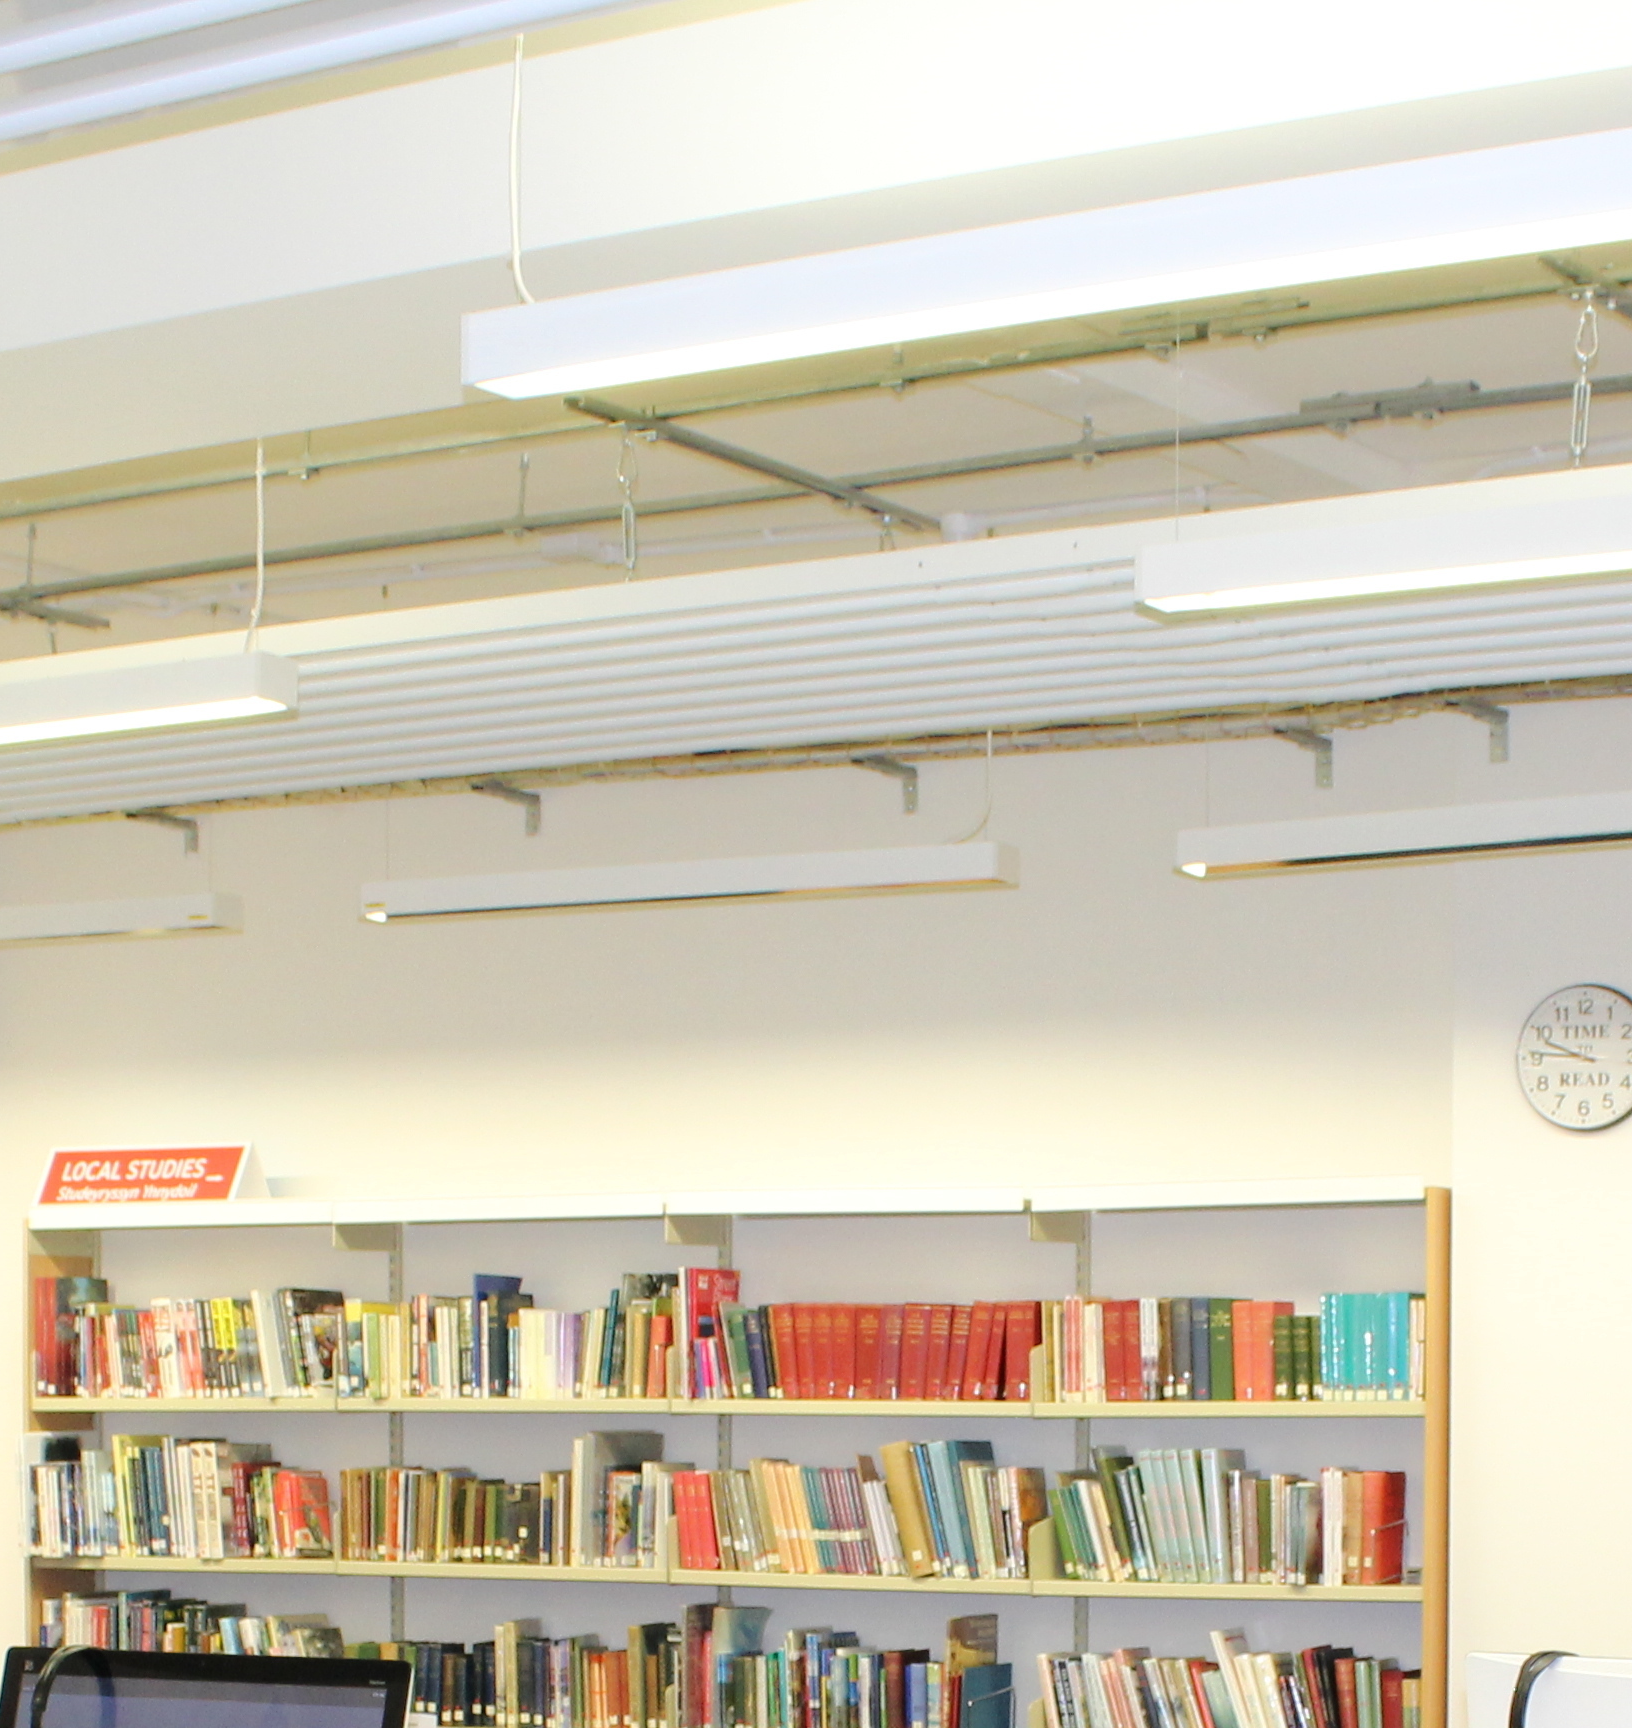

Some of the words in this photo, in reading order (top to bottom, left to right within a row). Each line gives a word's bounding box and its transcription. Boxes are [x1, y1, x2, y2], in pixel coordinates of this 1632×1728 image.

[1556, 1007, 1568, 1021] 11
[1578, 1000, 1593, 1015] 12
[1536, 1025, 1552, 1040] 10
[1562, 1025, 1610, 1038] TIME
[1621, 1024, 1632, 1039] 2
[1537, 1076, 1549, 1091] 8
[1559, 1073, 1610, 1087] READ
[1620, 1075, 1631, 1090] 4
[1555, 1095, 1566, 1109] 7
[1578, 1101, 1589, 1116] 6
[1603, 1094, 1614, 1109] 5
[61, 1160, 121, 1182] LOCAL
[125, 1157, 207, 1181] STUDIES
